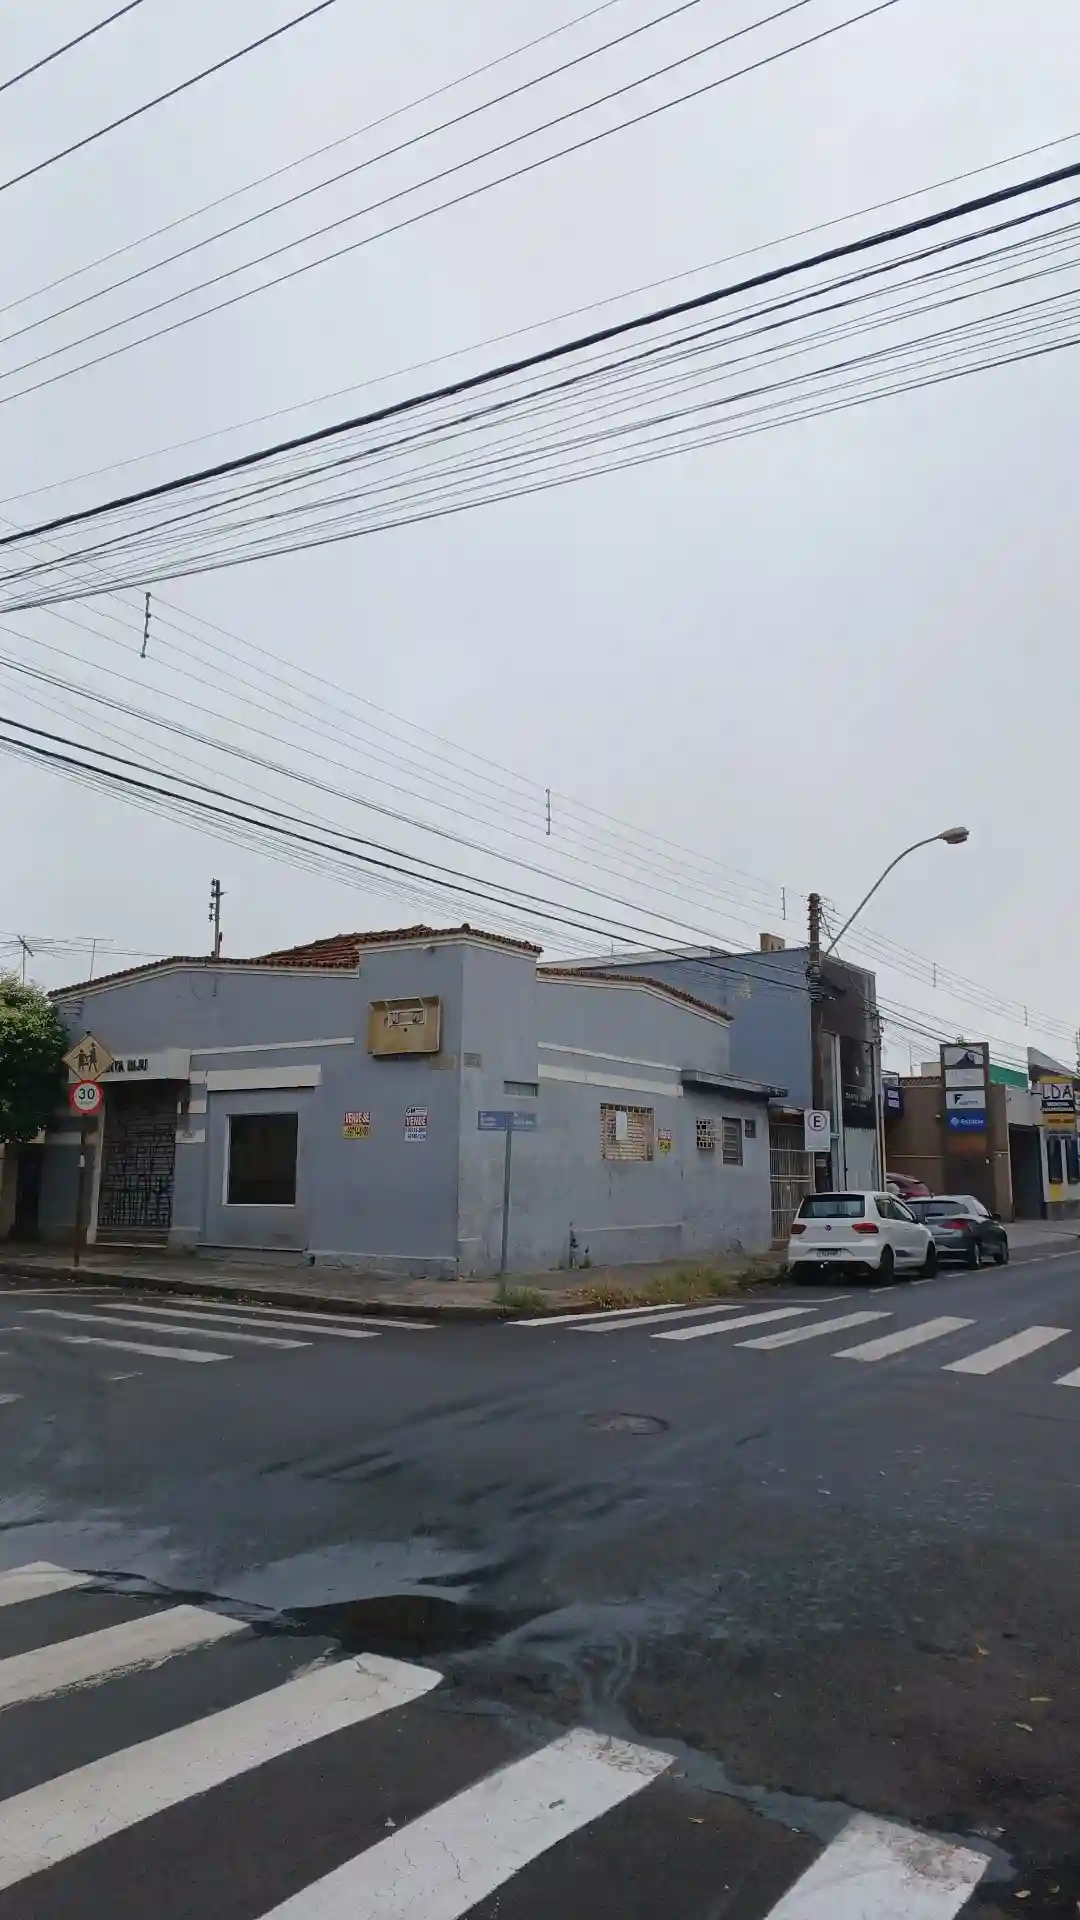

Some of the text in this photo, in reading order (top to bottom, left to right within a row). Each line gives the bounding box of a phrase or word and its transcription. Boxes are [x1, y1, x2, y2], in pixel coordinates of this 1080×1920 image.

[78, 1088, 96, 1100] 30
[406, 1116, 427, 1126] VENDE
[813, 1115, 822, 1128] E
